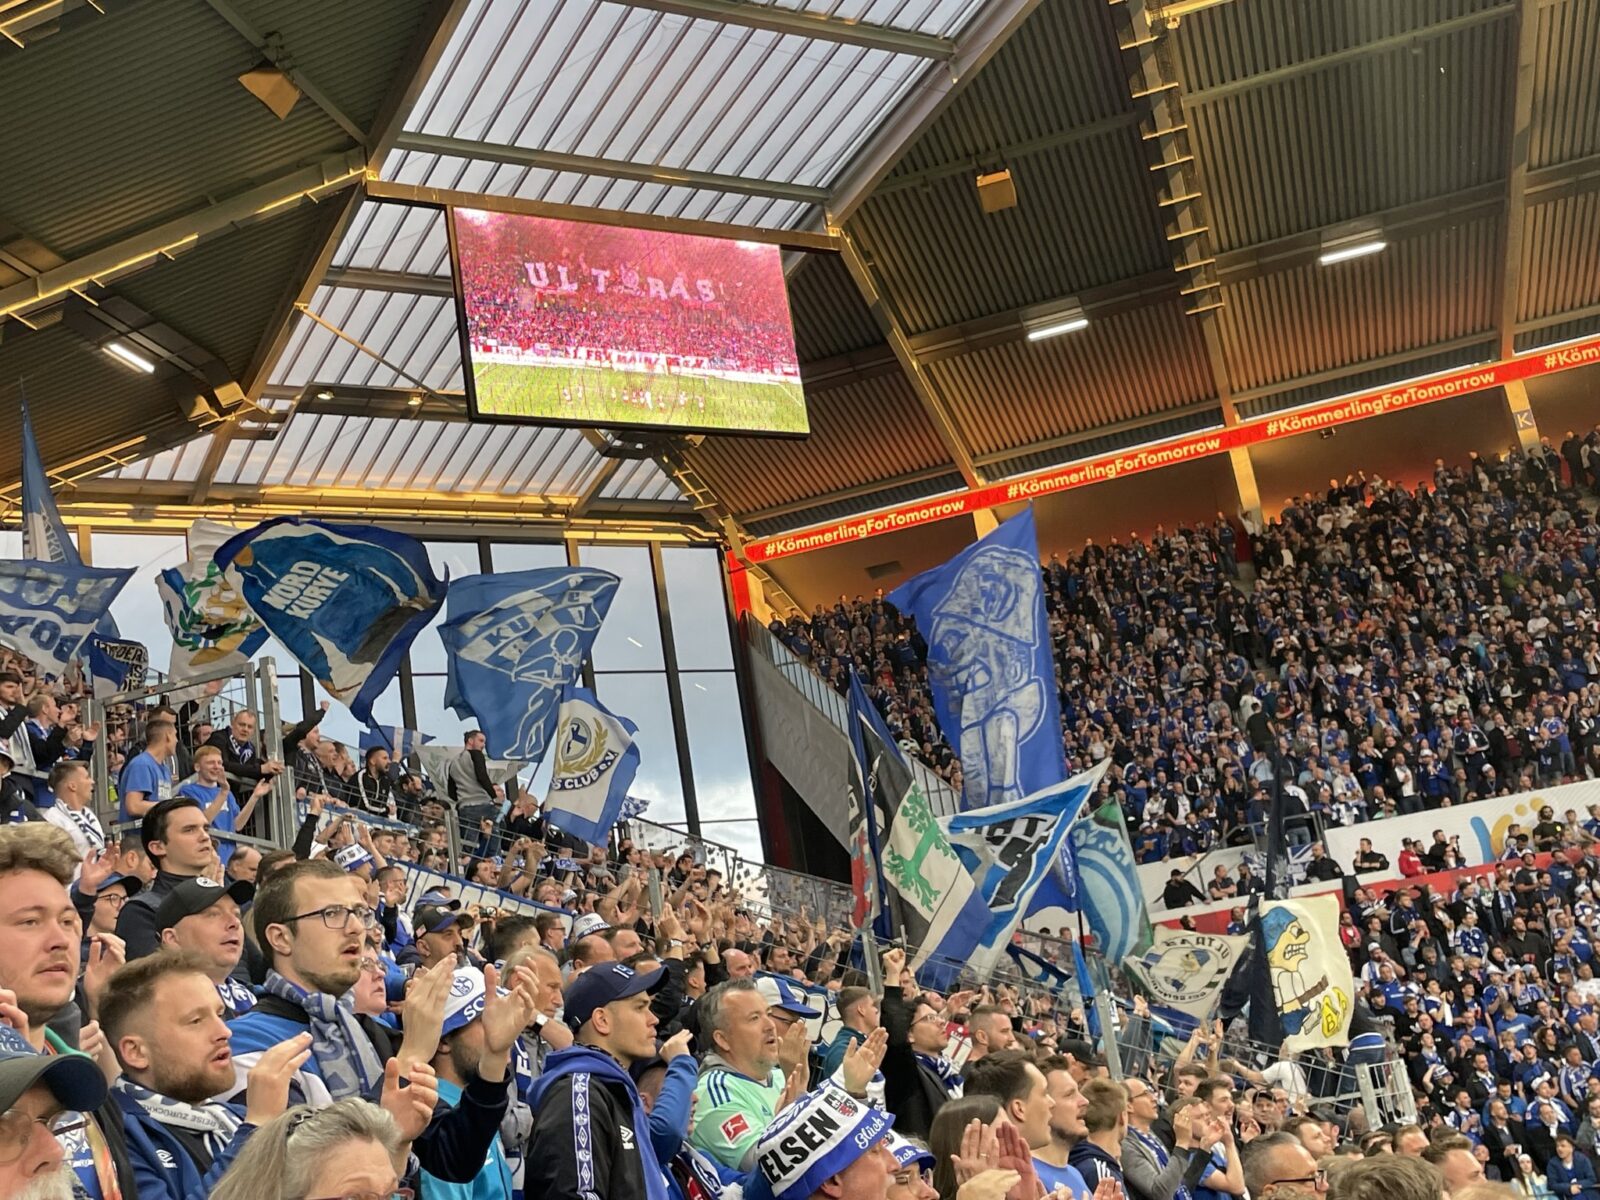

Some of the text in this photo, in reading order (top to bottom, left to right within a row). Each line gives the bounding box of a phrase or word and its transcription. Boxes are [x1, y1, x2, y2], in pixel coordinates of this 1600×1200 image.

[1266, 370, 1496, 436] #KömmerlingForTomorrow
[1517, 412, 1533, 428] K
[1008, 437, 1221, 499] #KömmerlingForTomorrow
[765, 500, 965, 557] #KömmerlingForTomorrow
[261, 560, 322, 612] NORD
[285, 566, 350, 620] KURVE
[564, 768, 600, 790] CLUB
[854, 1115, 886, 1151] Glück
